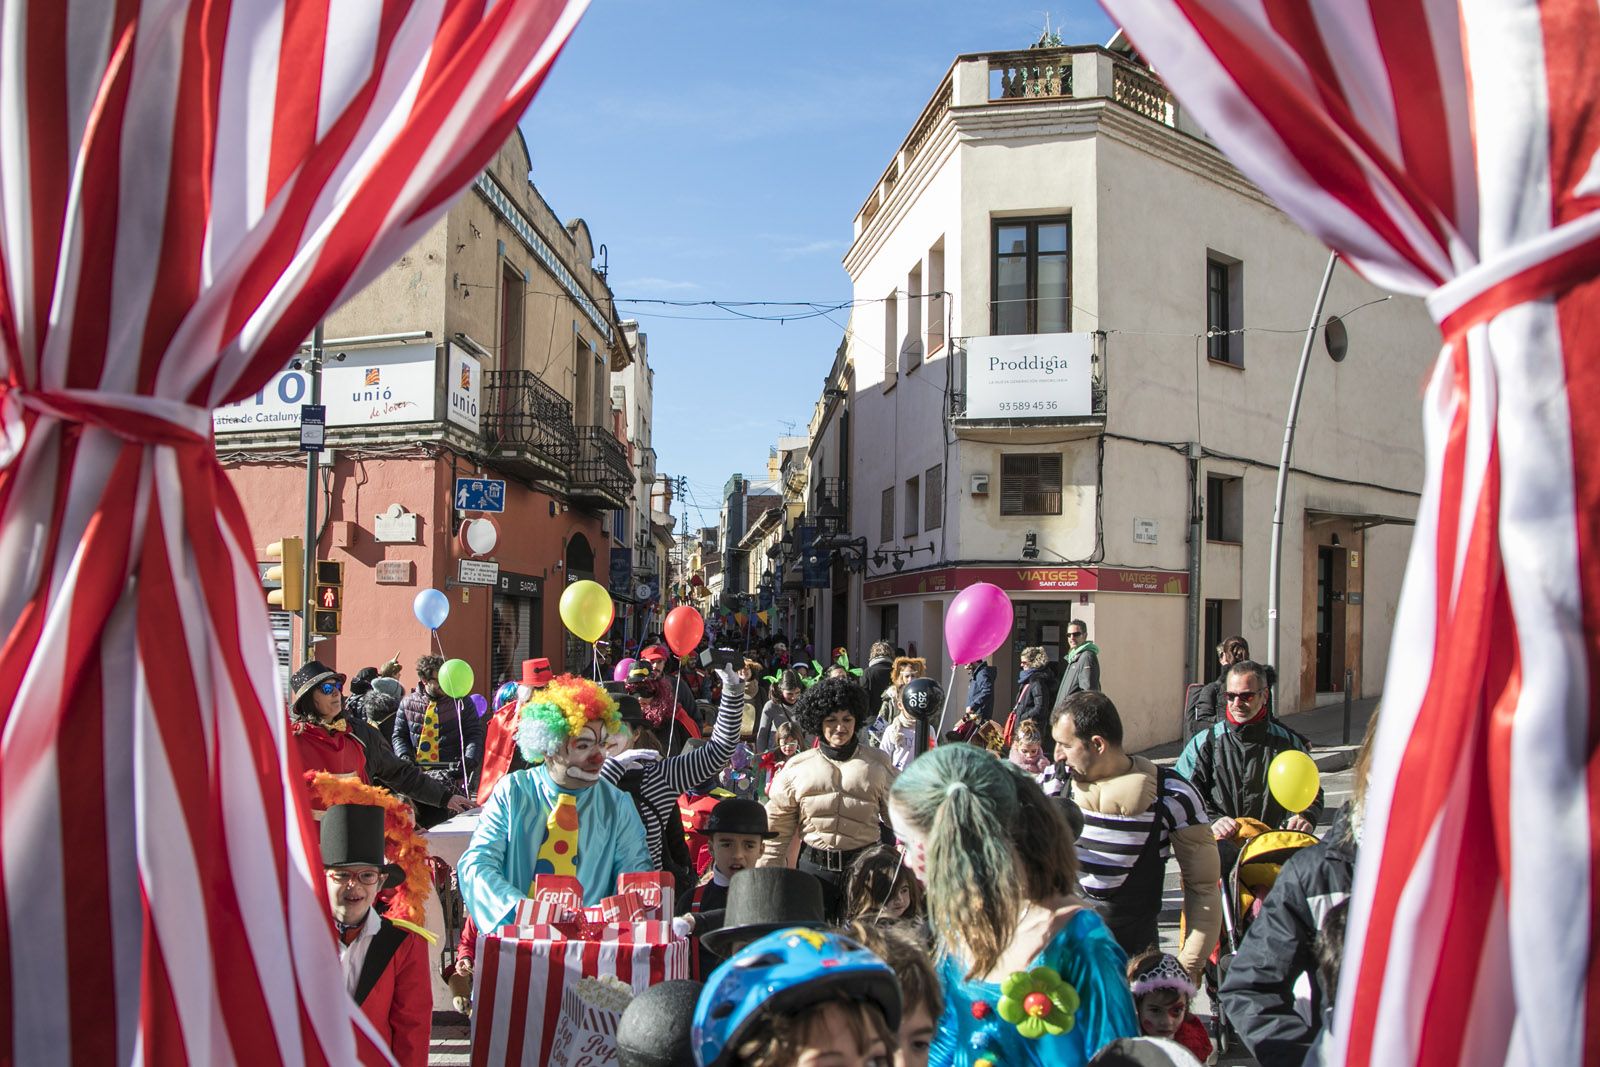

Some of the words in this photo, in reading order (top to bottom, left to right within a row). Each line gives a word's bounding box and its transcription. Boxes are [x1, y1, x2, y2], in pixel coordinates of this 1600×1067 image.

[989, 355, 1068, 375] Proddigia
[352, 386, 392, 402] unió
[452, 391, 477, 417] unió
[999, 402, 1011, 411] 93
[1012, 402, 1031, 411] 589
[1032, 401, 1044, 410] 45
[1046, 401, 1058, 410] 36
[240, 413, 253, 424] de
[1017, 570, 1079, 581] VIATGES
[1119, 571, 1158, 584] VIATGES
[909, 693, 918, 707] KG
[918, 692, 928, 709] 250
[557, 1016, 573, 1049] Pop
[580, 1034, 617, 1065] Pop
